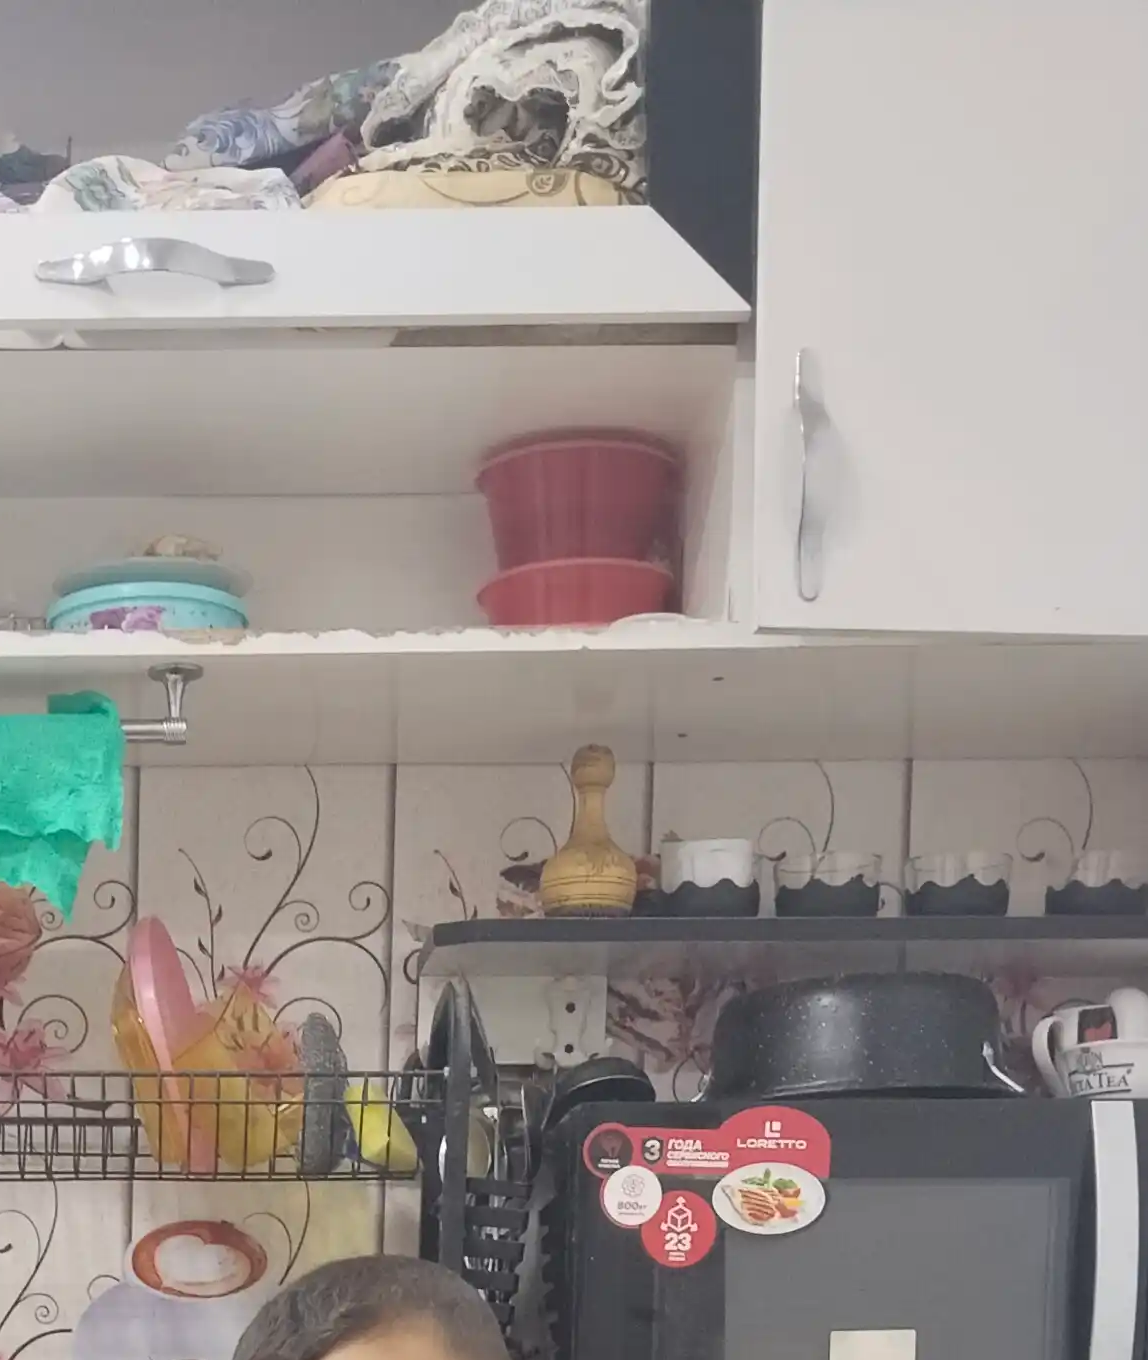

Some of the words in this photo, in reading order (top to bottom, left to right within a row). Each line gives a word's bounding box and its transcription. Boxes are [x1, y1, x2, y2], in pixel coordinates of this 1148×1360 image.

[1093, 1071, 1129, 1089] TEA
[644, 1139, 661, 1161] 3
[667, 1138, 702, 1150] ГОДА
[736, 1138, 807, 1150] LORETTO
[664, 1232, 692, 1251] 23
